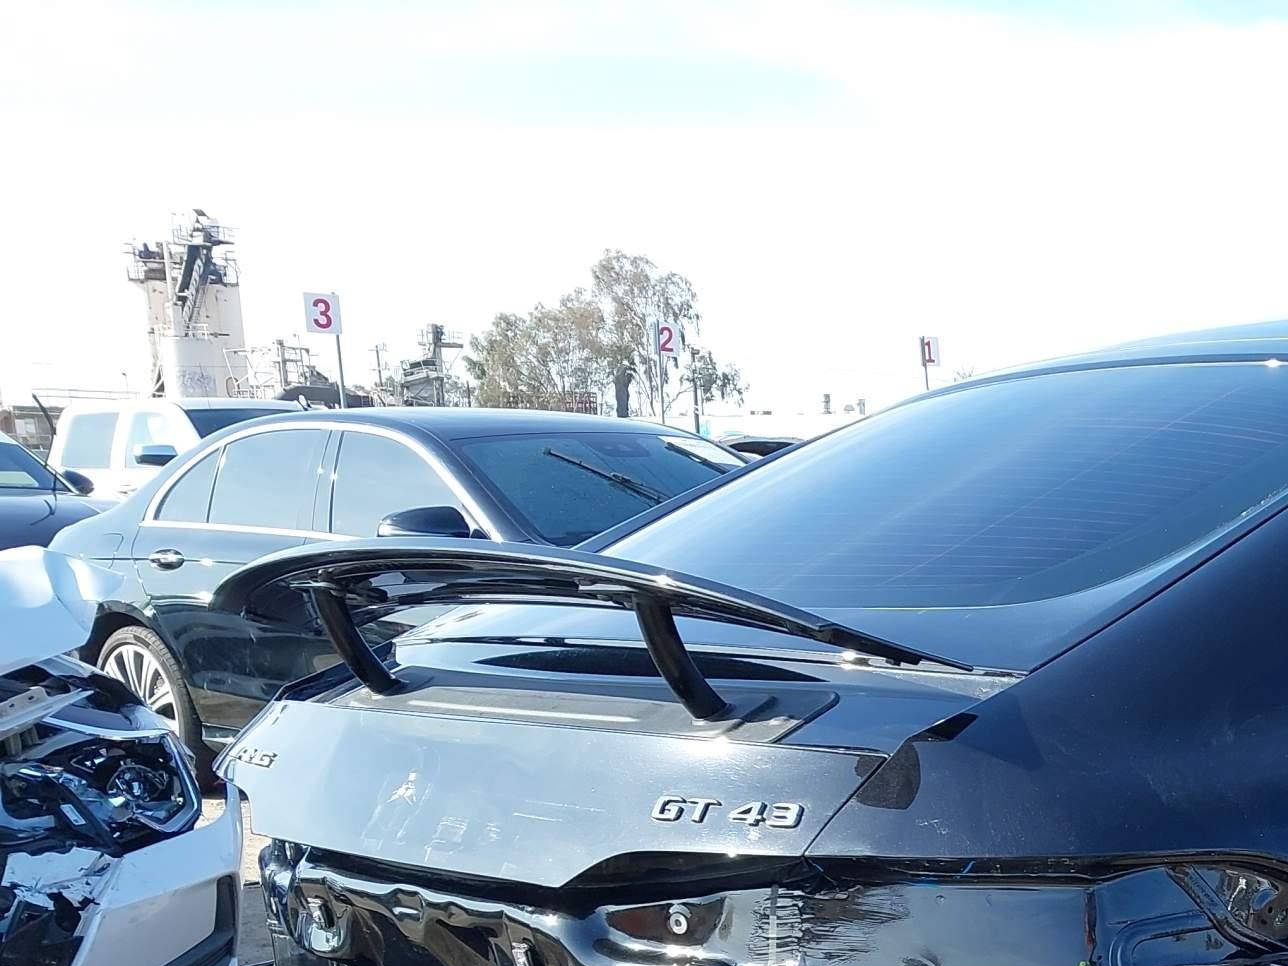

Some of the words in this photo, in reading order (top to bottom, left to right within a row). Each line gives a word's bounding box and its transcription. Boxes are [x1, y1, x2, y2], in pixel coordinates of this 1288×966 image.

[312, 298, 332, 329] 3
[660, 326, 674, 352] 2
[925, 340, 935, 363] 1
[651, 795, 722, 824] GT
[728, 801, 805, 829] 43
